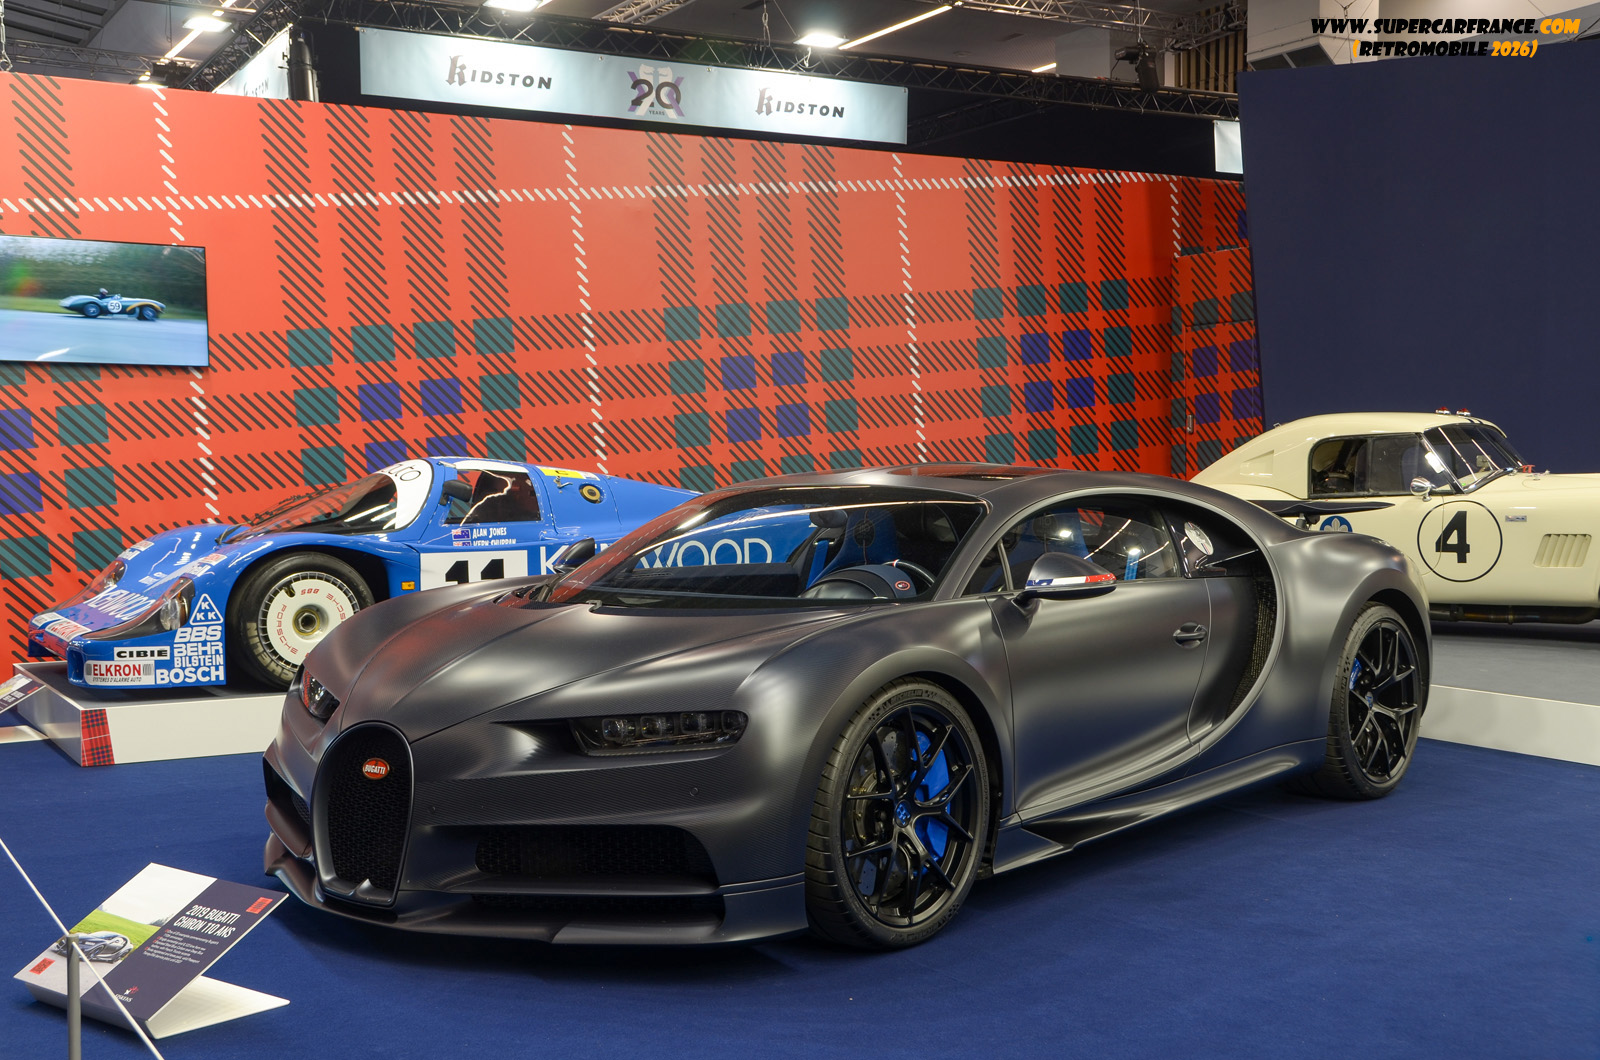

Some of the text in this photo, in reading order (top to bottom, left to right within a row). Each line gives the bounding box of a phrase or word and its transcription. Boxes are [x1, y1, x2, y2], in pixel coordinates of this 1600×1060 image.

[631, 79, 682, 109] 20
[109, 302, 121, 311] 59
[473, 527, 507, 539] ALAN JONES
[1435, 510, 1471, 564] 4
[174, 626, 222, 643] BBS
[174, 642, 224, 657] BEHR
[174, 654, 224, 668] BILSTEIN
[93, 664, 142, 676] ELKRON
[156, 666, 225, 684] BOSCH
[364, 764, 386, 775] BUGATTI
[185, 904, 242, 925] 2019 BUGATTI
[173, 915, 236, 938] CHIRON 110 ANS
